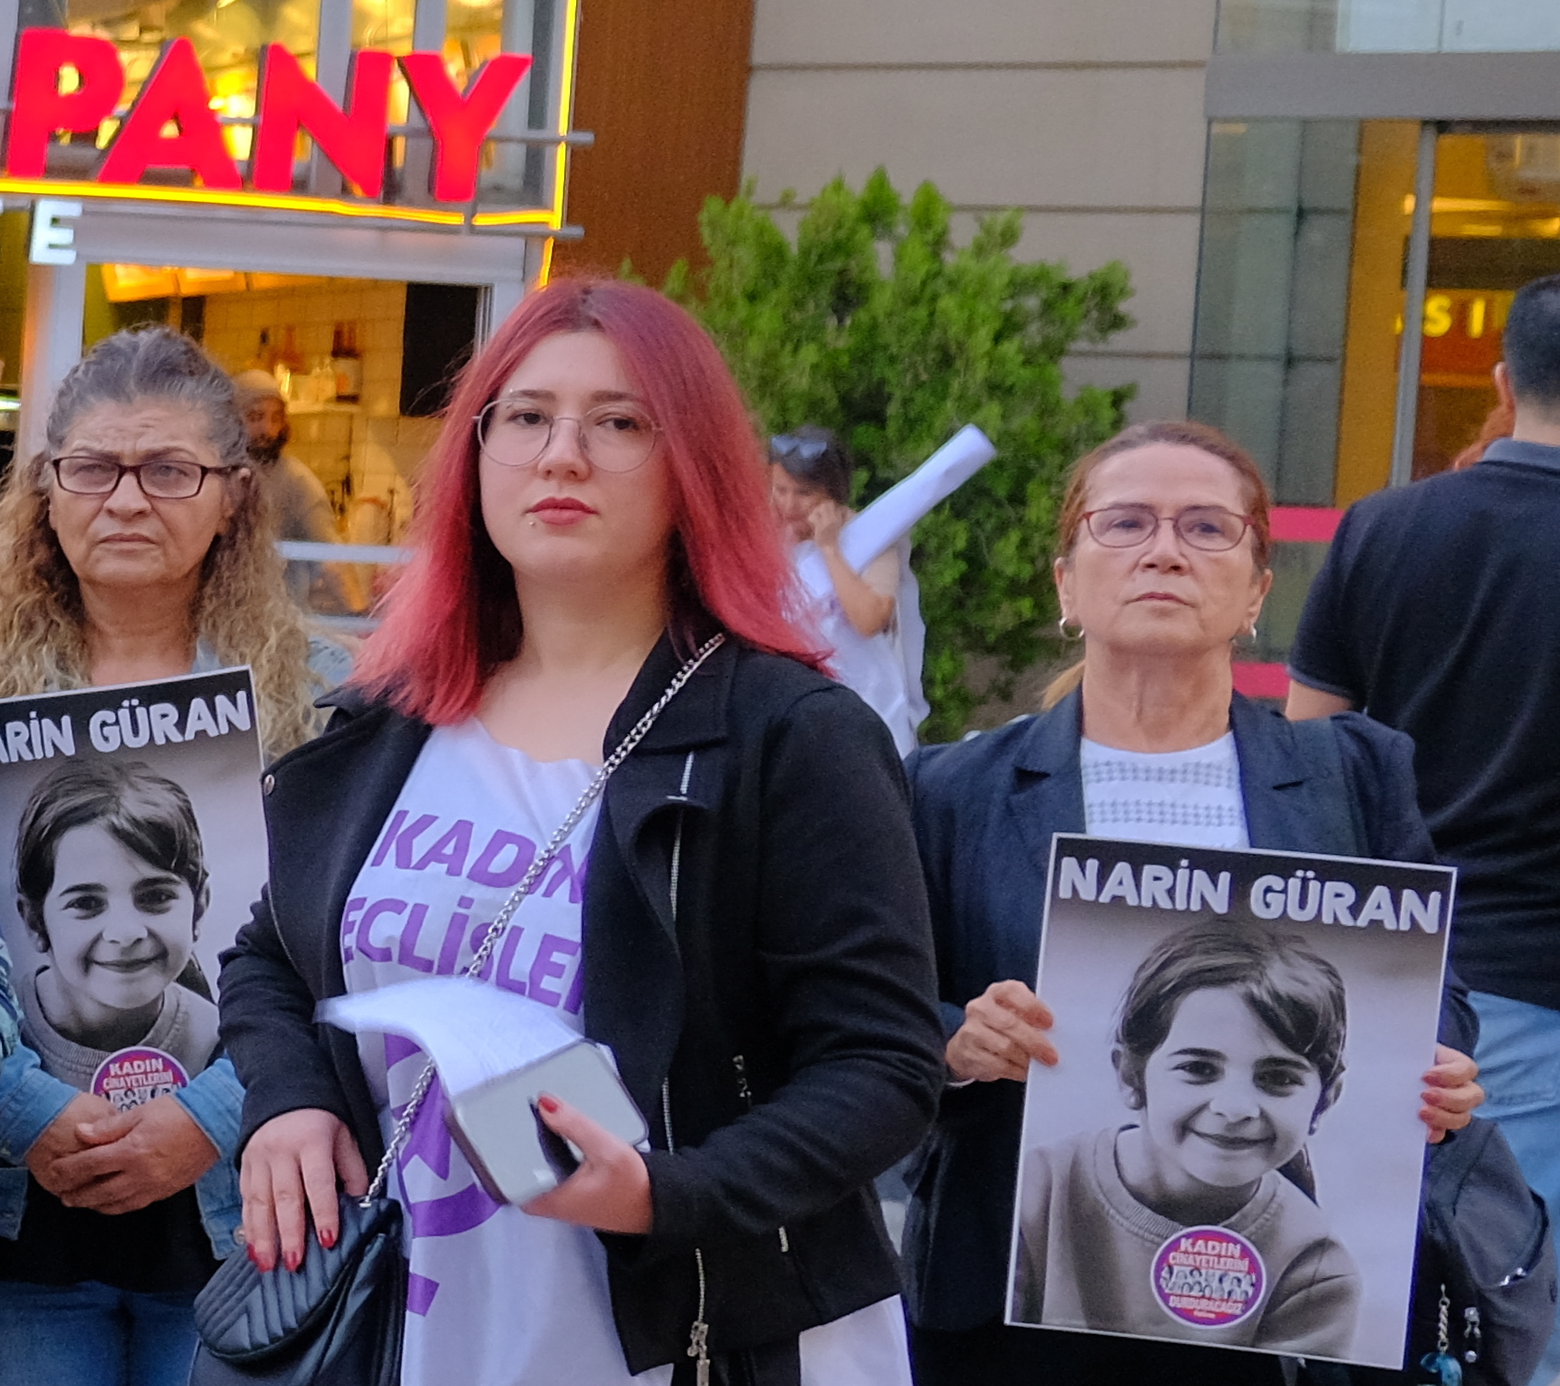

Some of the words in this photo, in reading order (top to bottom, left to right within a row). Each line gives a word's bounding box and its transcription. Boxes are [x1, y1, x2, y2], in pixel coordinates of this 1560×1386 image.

[88, 690, 252, 753] GÜRAN
[1058, 856, 1231, 914] NARİN
[1249, 869, 1442, 934] GÜRAN
[109, 1058, 164, 1076] KADIN
[1179, 1237, 1241, 1258] KADIN
